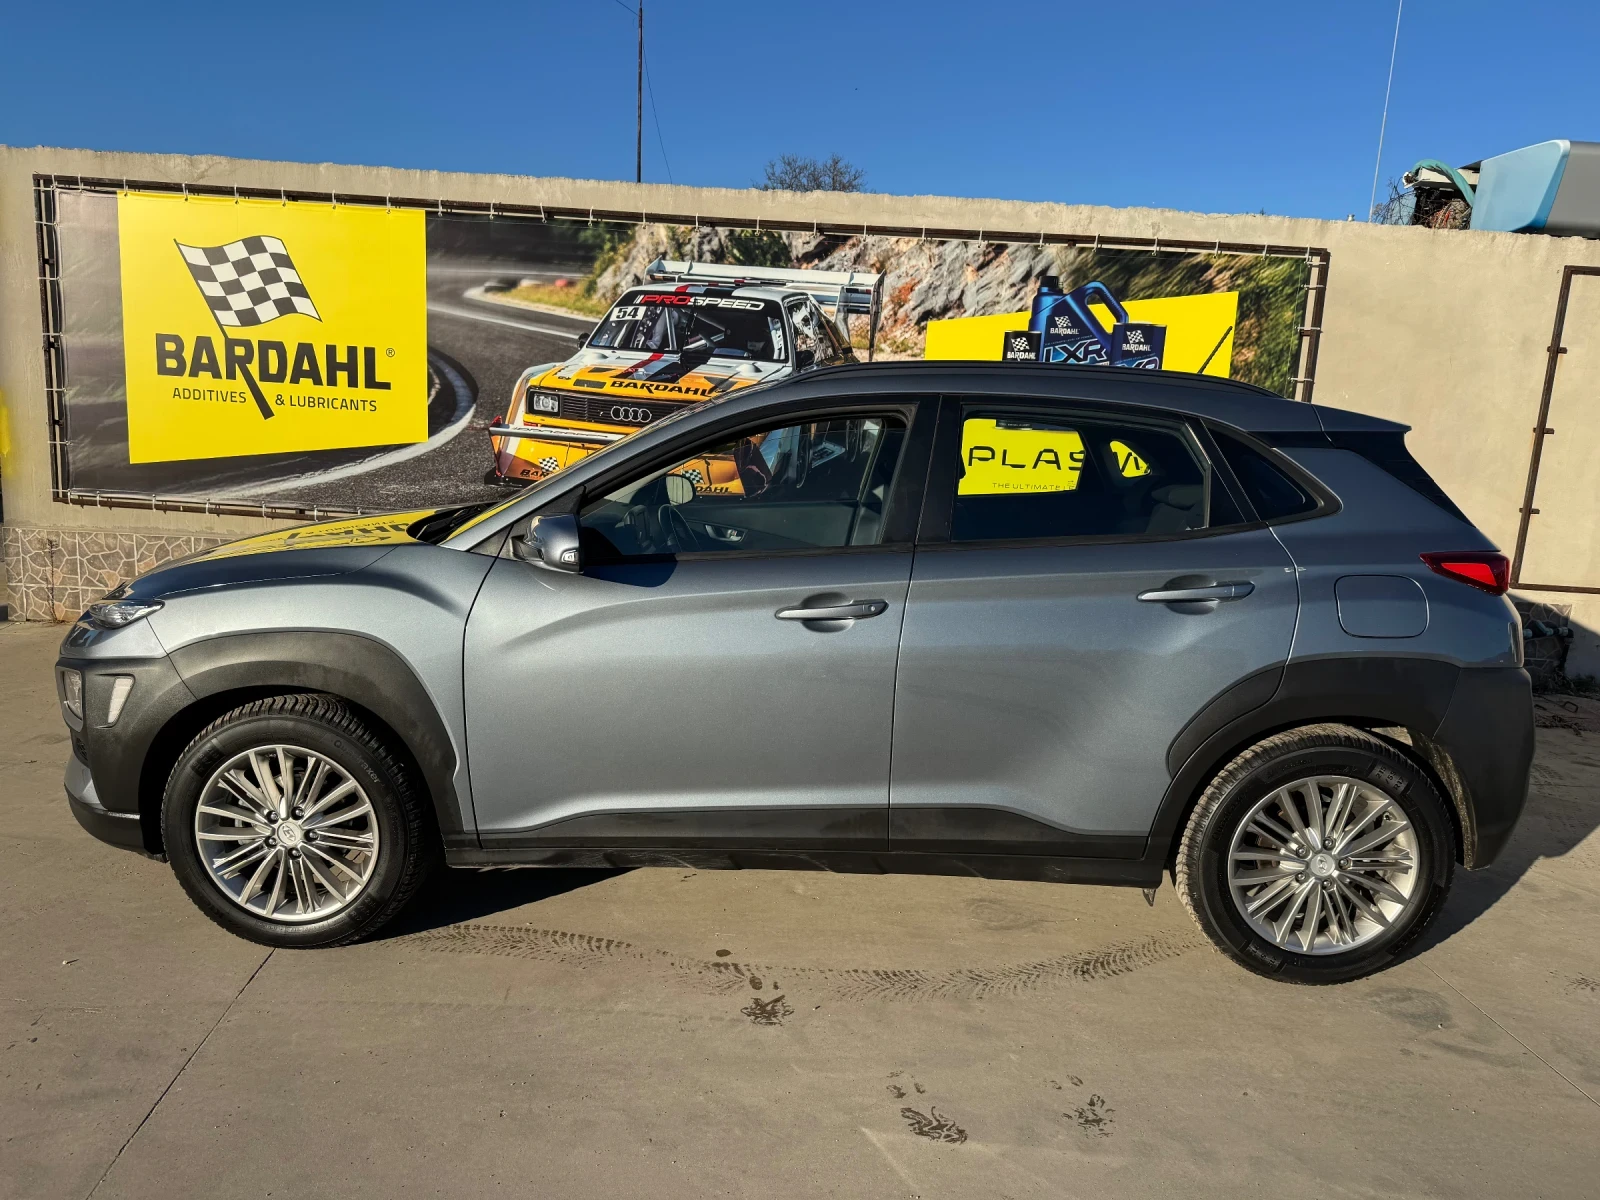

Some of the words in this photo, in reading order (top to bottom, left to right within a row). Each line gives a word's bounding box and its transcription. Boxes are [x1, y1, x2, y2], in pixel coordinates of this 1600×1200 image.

[640, 294, 765, 311] PROSPEED
[615, 307, 639, 320] 54
[1050, 327, 1080, 337] BARDAHL
[1122, 343, 1152, 353] BARDAHL
[1006, 351, 1037, 361] BARDAHL
[156, 333, 391, 420] BARDAHL
[610, 381, 712, 398] BARDAHL
[172, 387, 247, 403] ADDITIVES
[275, 393, 286, 406] &
[289, 395, 378, 412] LUBRICANTS
[1012, 483, 1061, 491] ULTIMATE
